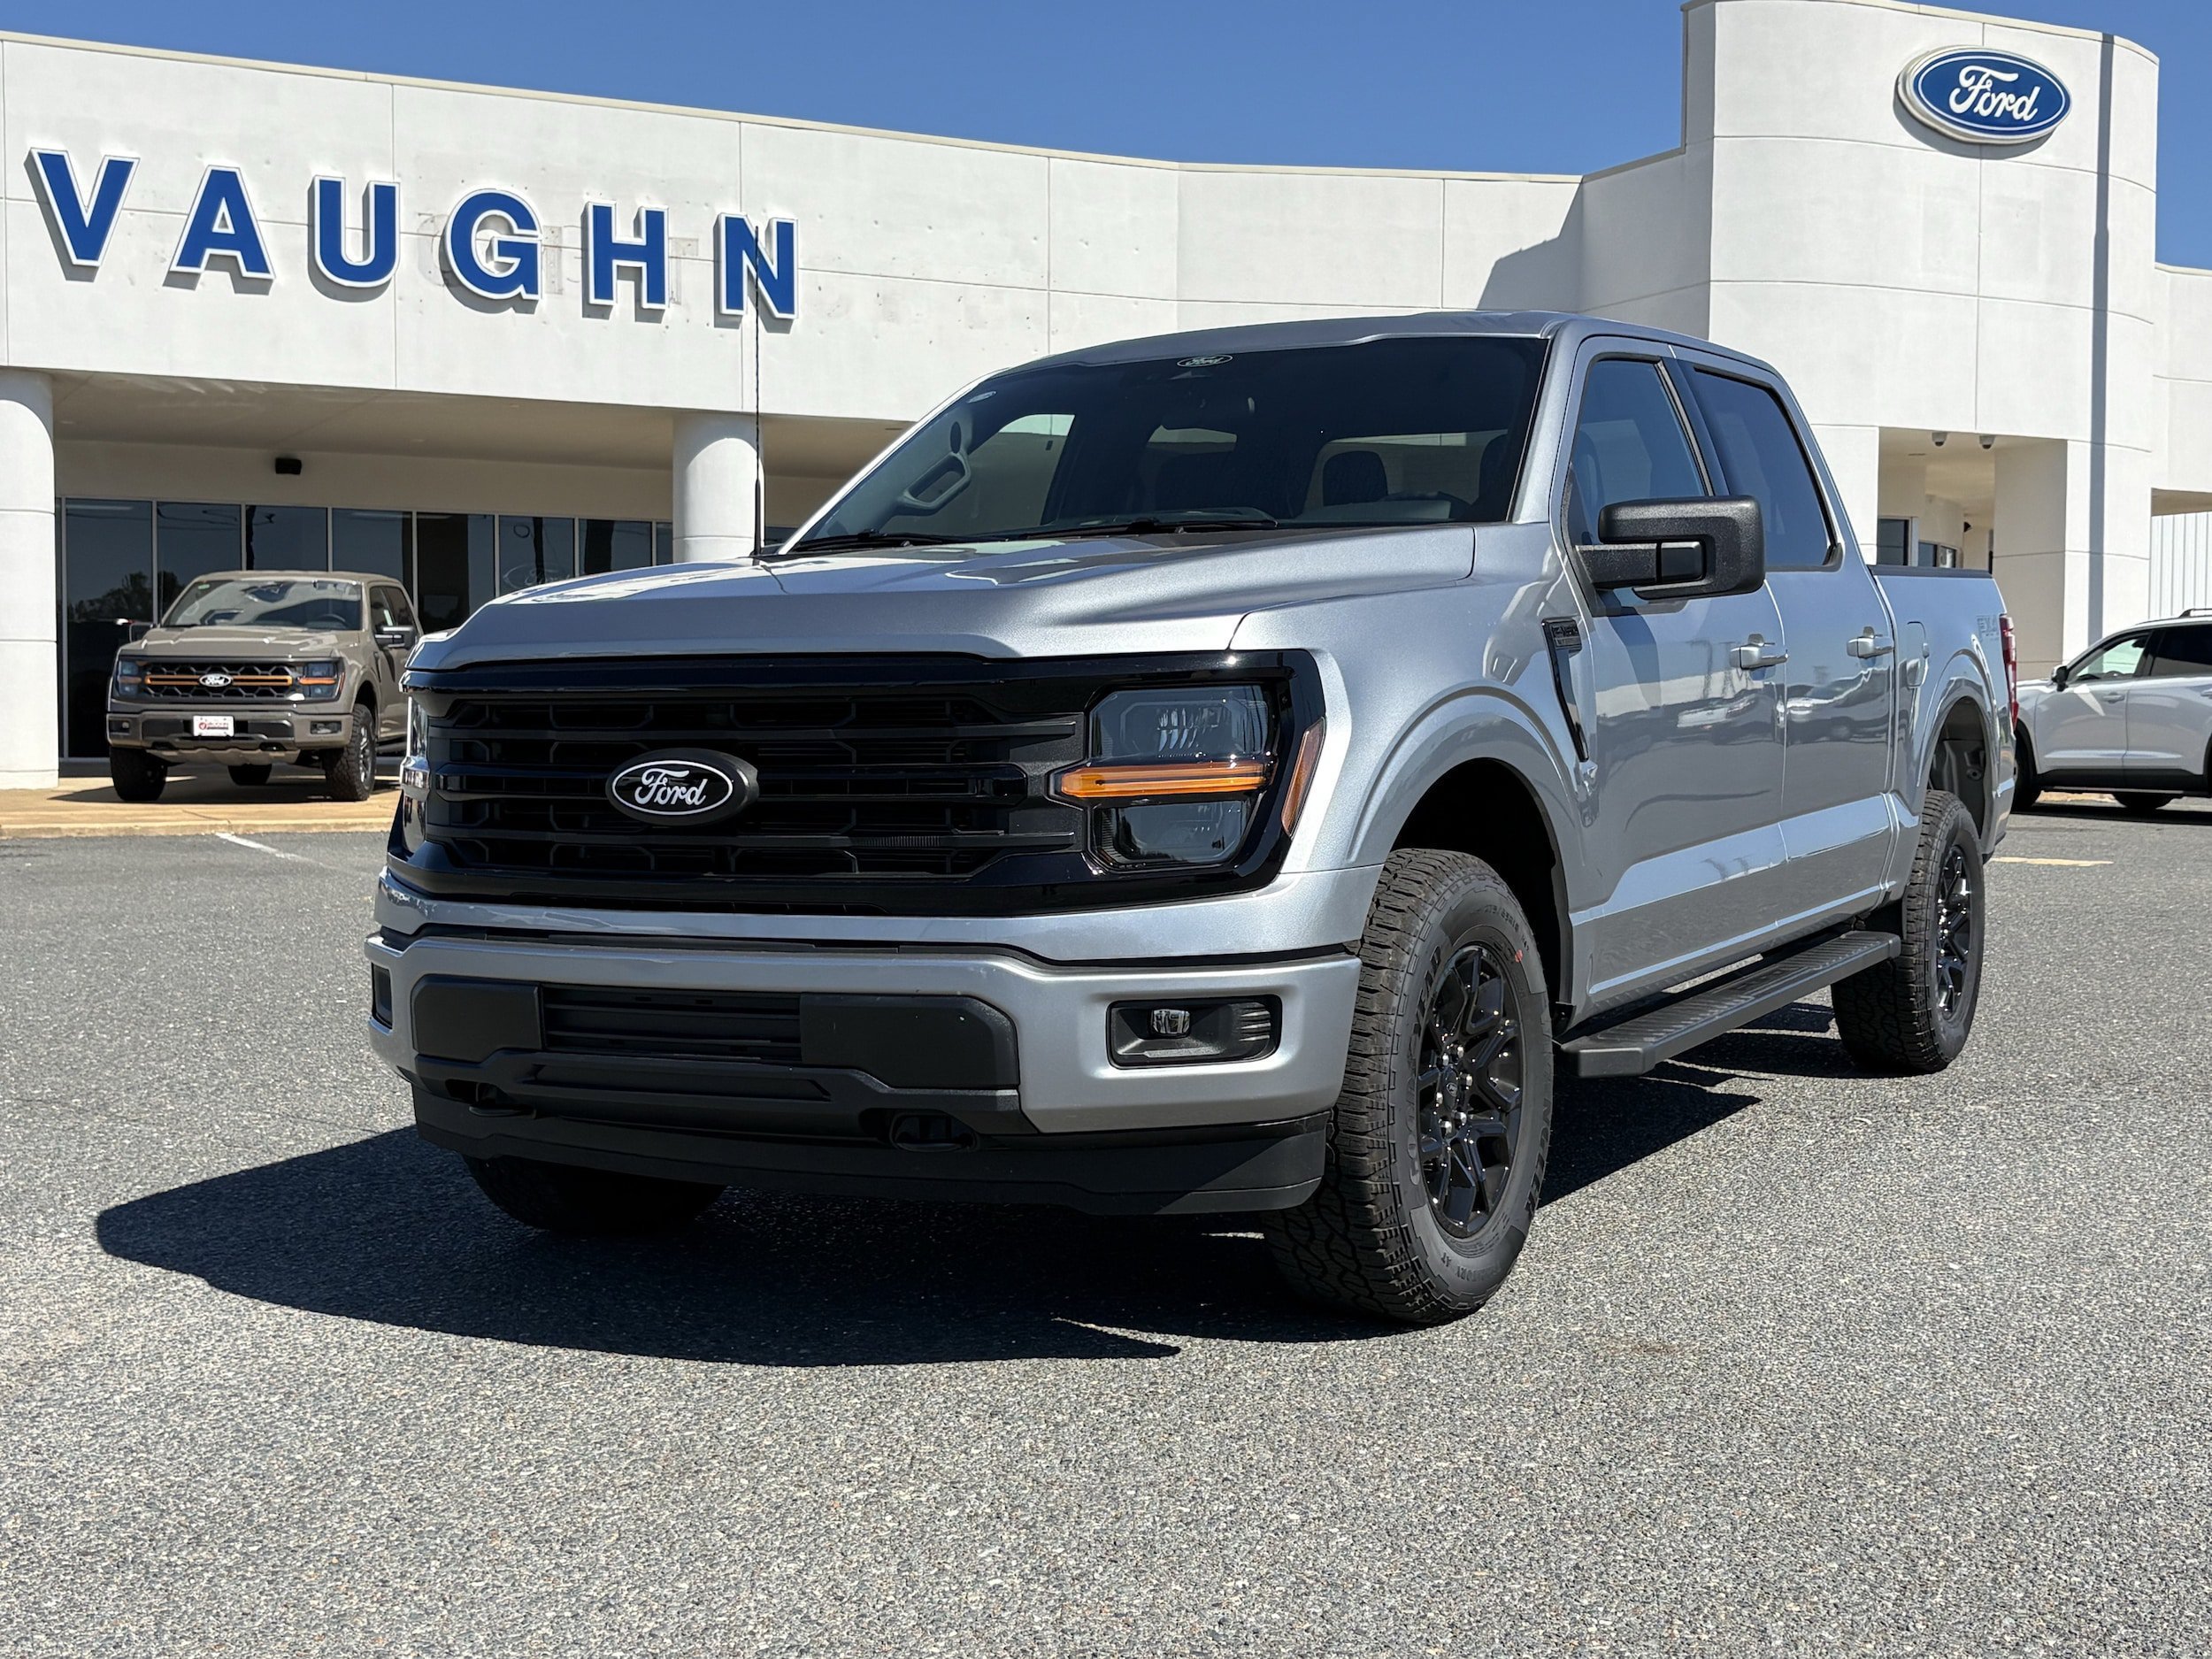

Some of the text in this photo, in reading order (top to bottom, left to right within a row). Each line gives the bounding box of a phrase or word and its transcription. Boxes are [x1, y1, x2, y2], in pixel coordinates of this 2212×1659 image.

[1949, 65, 2041, 121] Ford
[30, 147, 801, 320] VAUGHN
[634, 768, 707, 805] Ford
